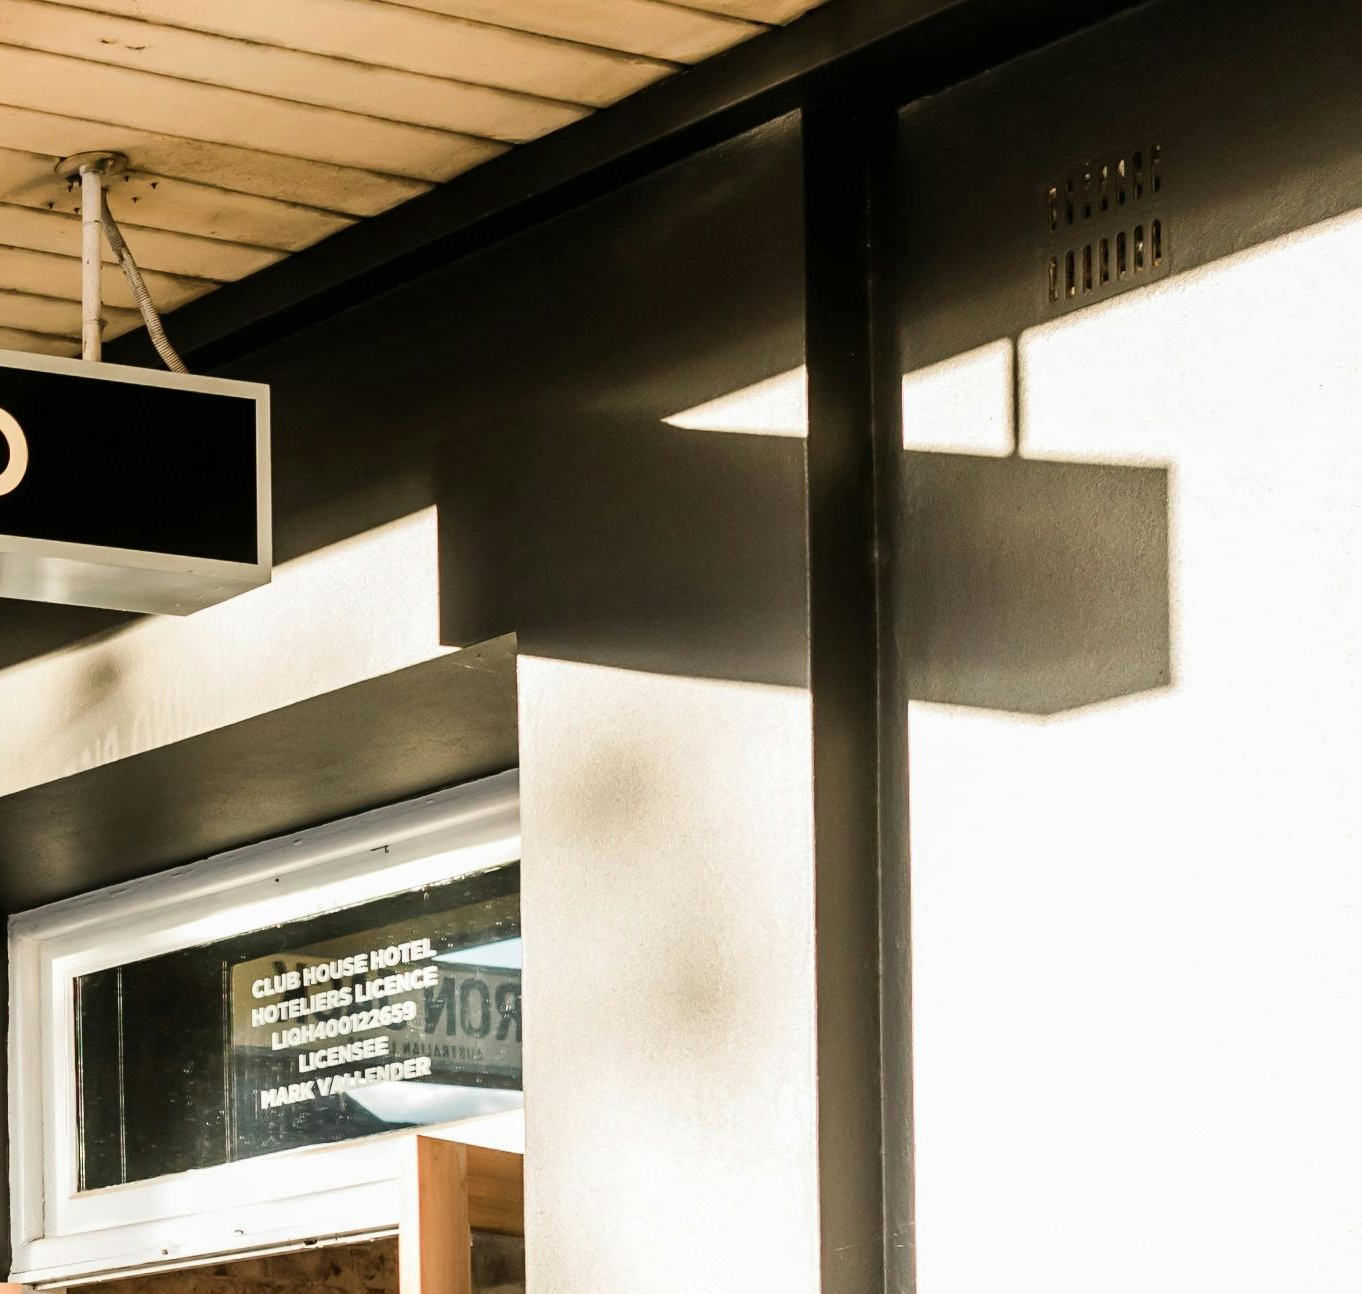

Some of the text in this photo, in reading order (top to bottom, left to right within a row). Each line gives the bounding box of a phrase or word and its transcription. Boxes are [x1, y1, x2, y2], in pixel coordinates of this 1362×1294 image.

[251, 971, 301, 999] CLUB
[303, 952, 369, 987] HOUSE
[370, 937, 437, 971] HOTEL
[251, 986, 353, 1028] HOTELIERS
[355, 966, 439, 1003] LICENCE
[298, 1036, 389, 1073] LICENSEE
[260, 1079, 316, 1109] MARK
